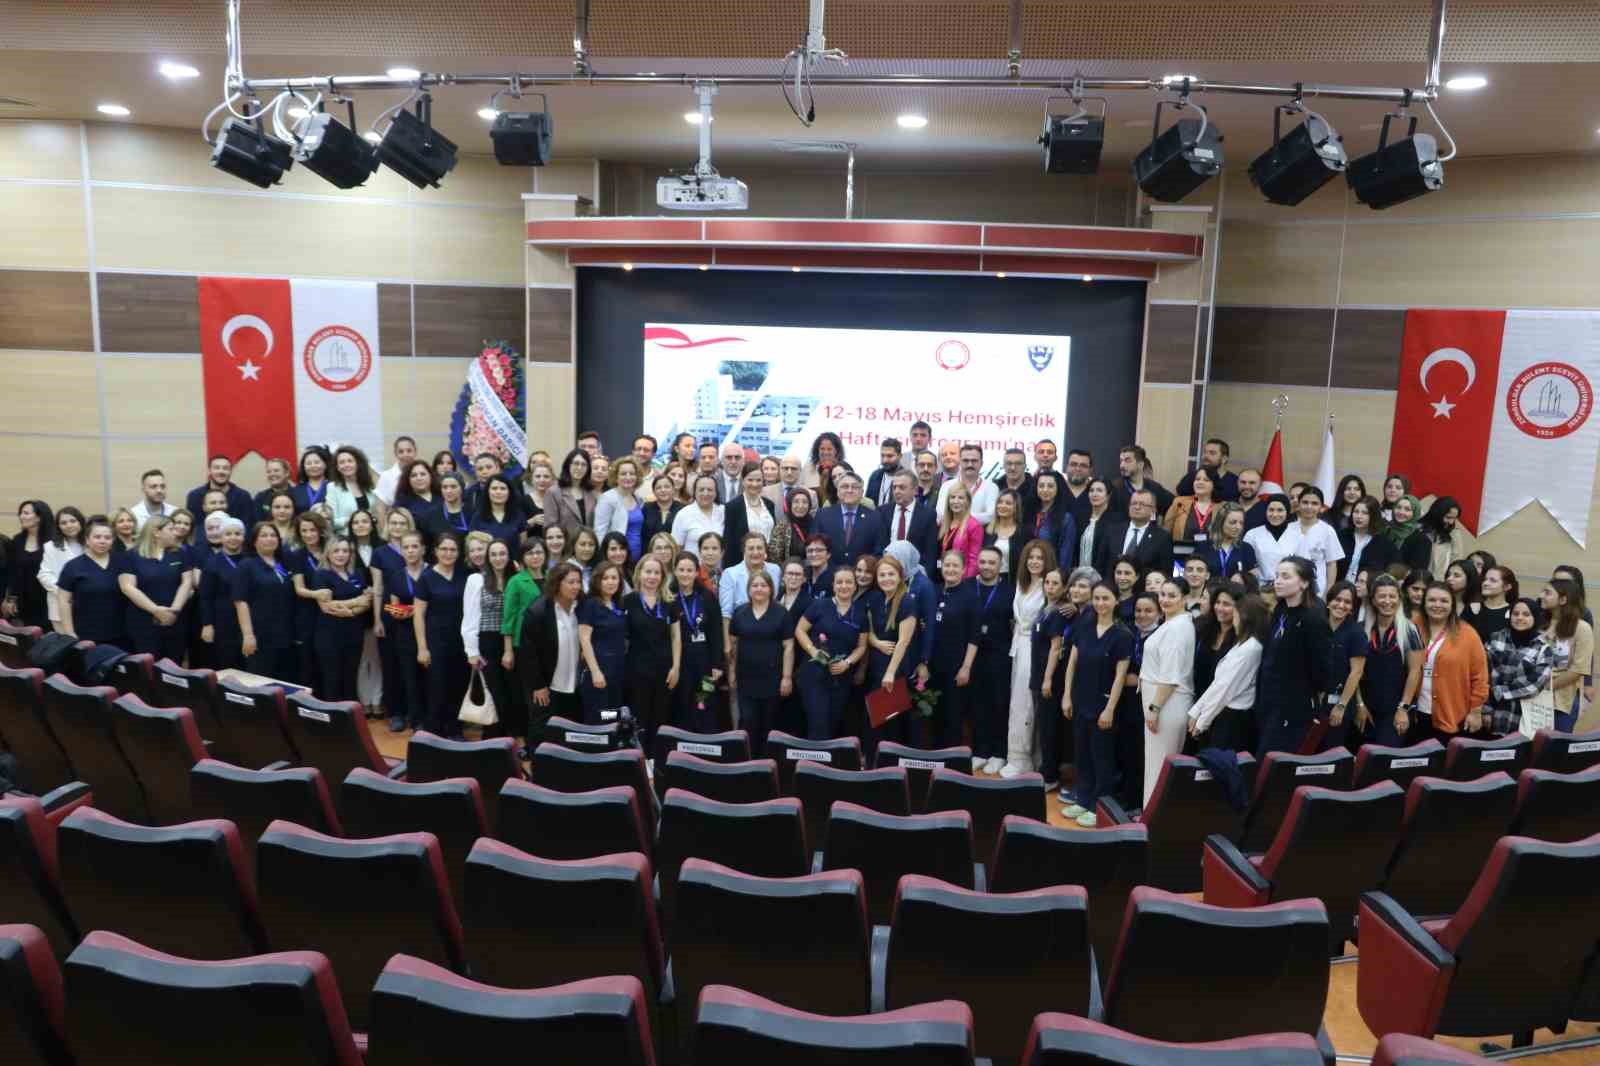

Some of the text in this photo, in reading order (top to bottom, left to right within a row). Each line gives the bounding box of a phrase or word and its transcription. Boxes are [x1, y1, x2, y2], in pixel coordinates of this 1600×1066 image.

[823, 405, 1056, 427] 12-18 Mayıs Hemşirelik
